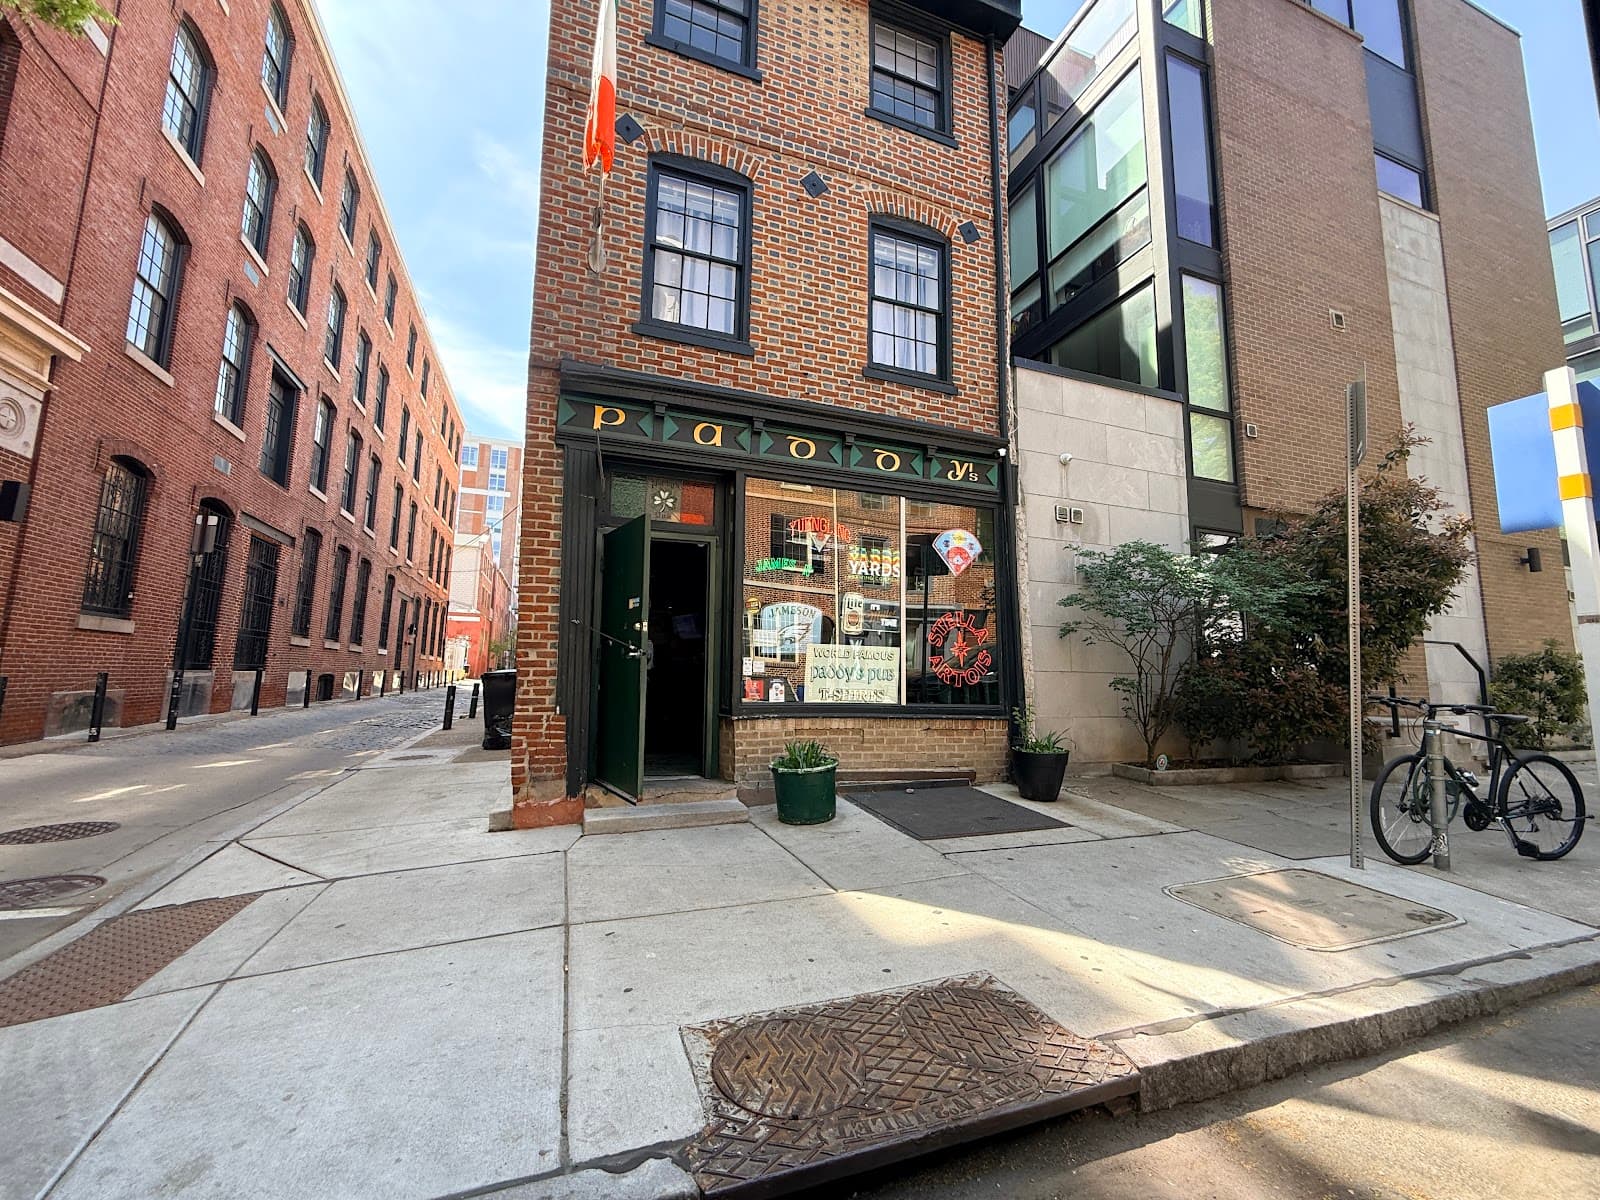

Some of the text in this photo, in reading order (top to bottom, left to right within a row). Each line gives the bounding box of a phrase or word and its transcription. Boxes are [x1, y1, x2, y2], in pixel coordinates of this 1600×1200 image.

[788, 516, 851, 543] YUENGLNG
[847, 558, 900, 577] YARDS
[768, 605, 817, 619] JAMESON
[847, 597, 863, 610] Lite
[928, 611, 989, 647] STELLA
[813, 647, 895, 661] WORLD FAMOUS
[928, 650, 992, 688] ARTOIS
